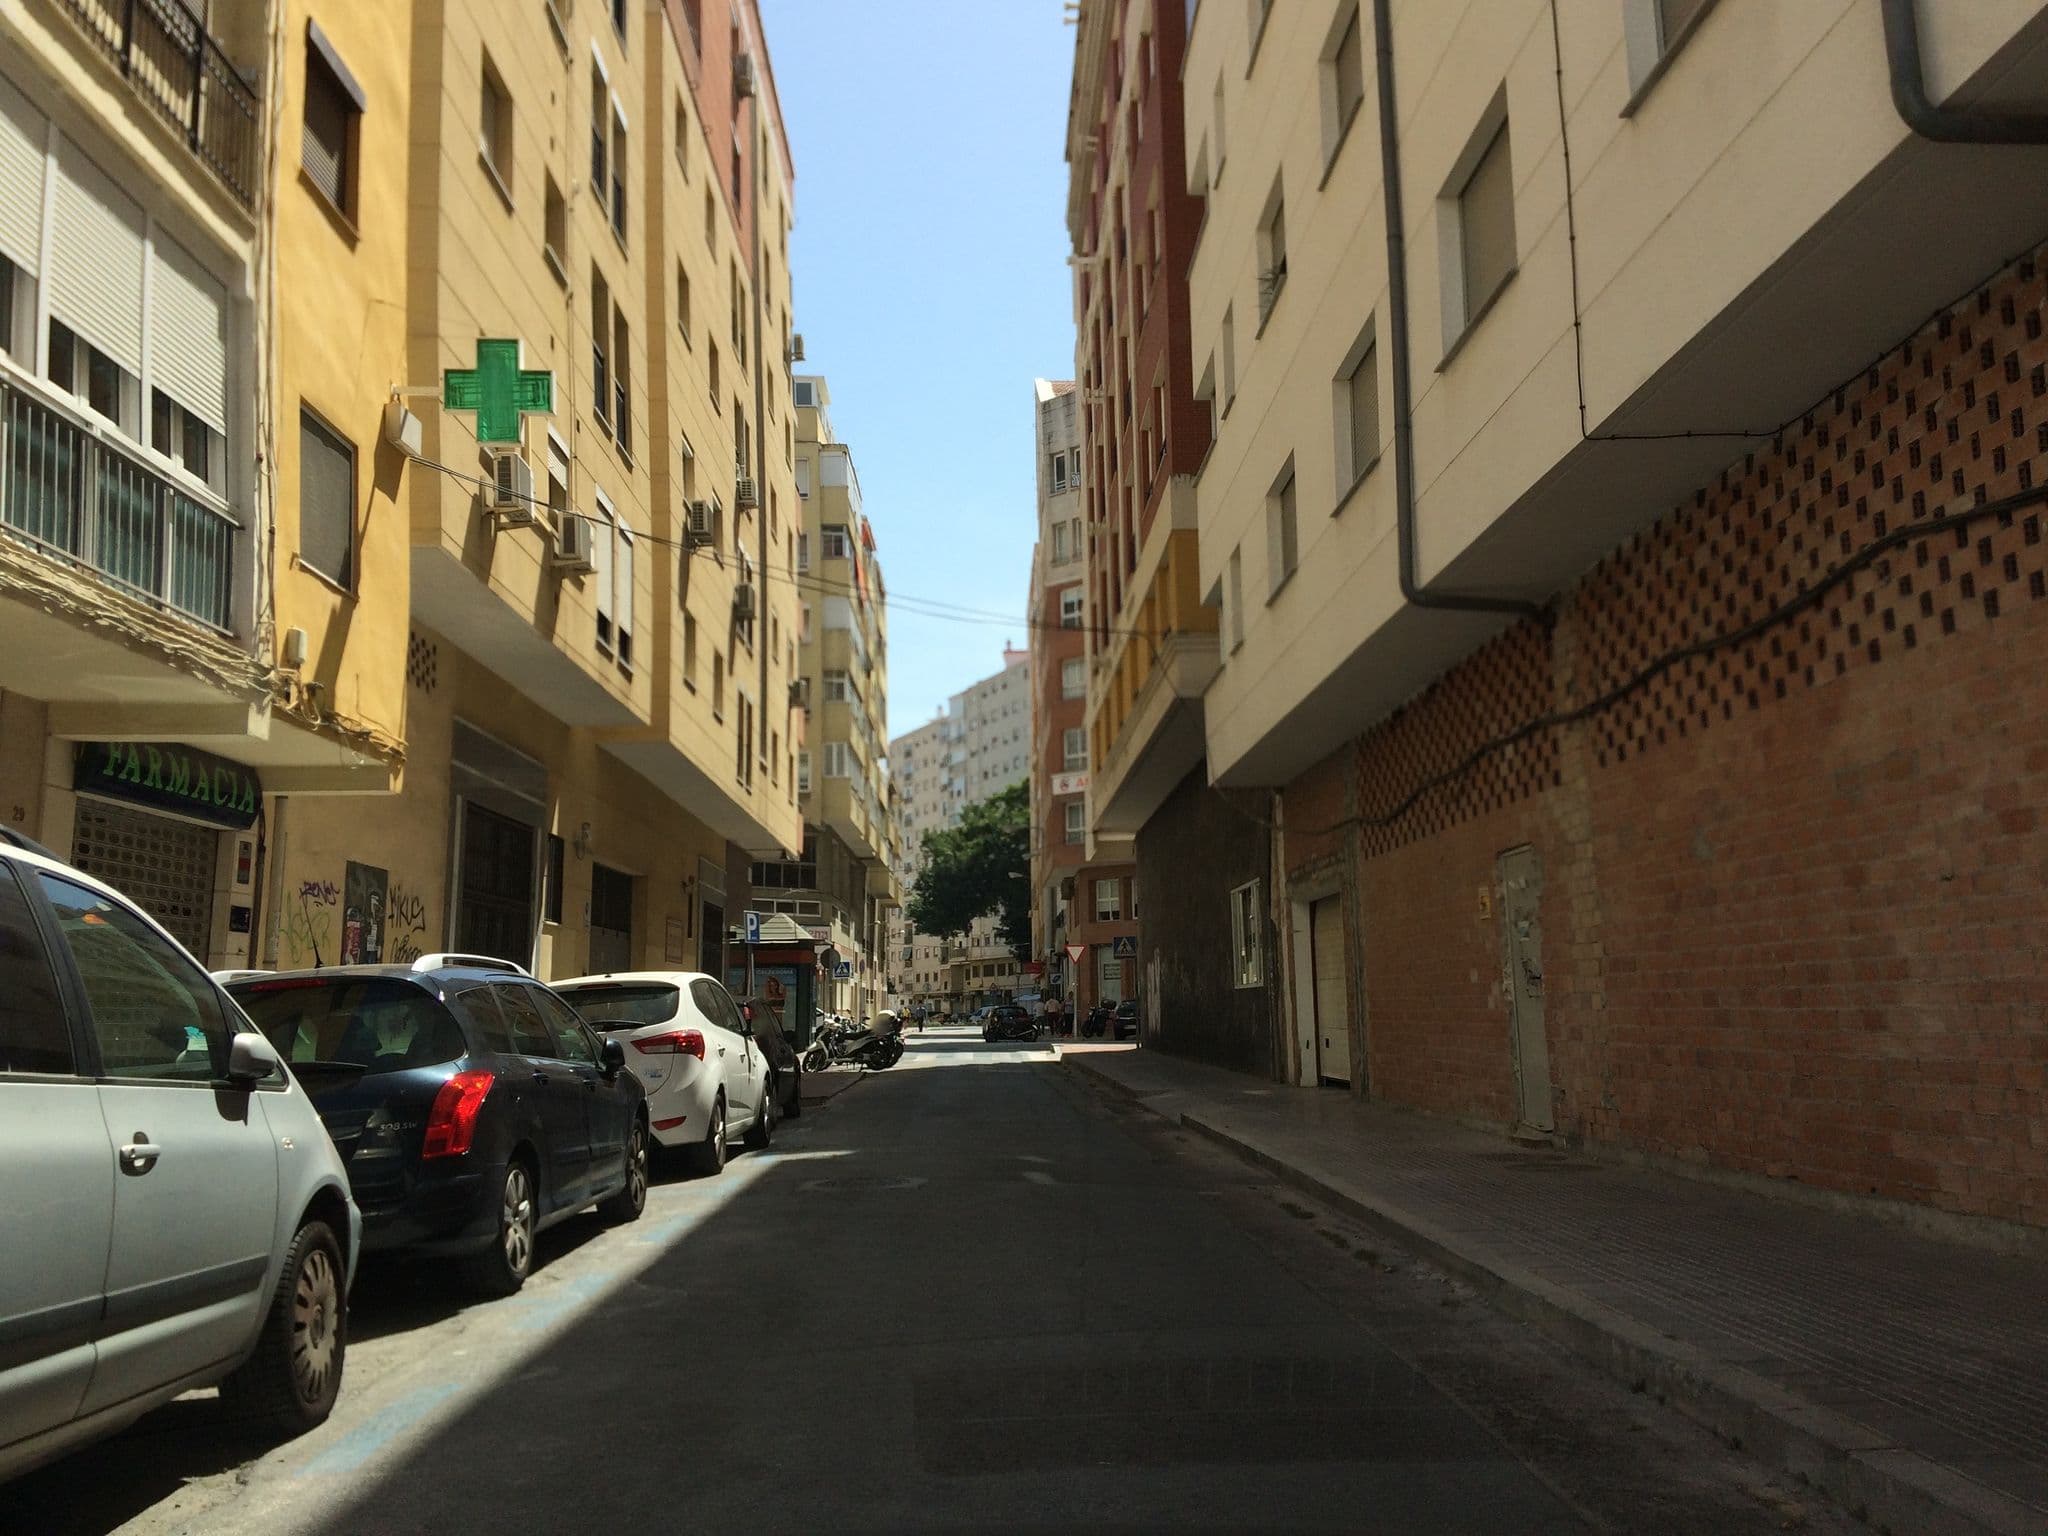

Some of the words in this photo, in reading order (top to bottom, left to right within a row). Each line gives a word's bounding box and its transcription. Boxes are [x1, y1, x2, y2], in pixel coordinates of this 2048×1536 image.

[103, 743, 255, 814] FARMACIA
[747, 913, 757, 941] P
[378, 1122, 401, 1132] 308
